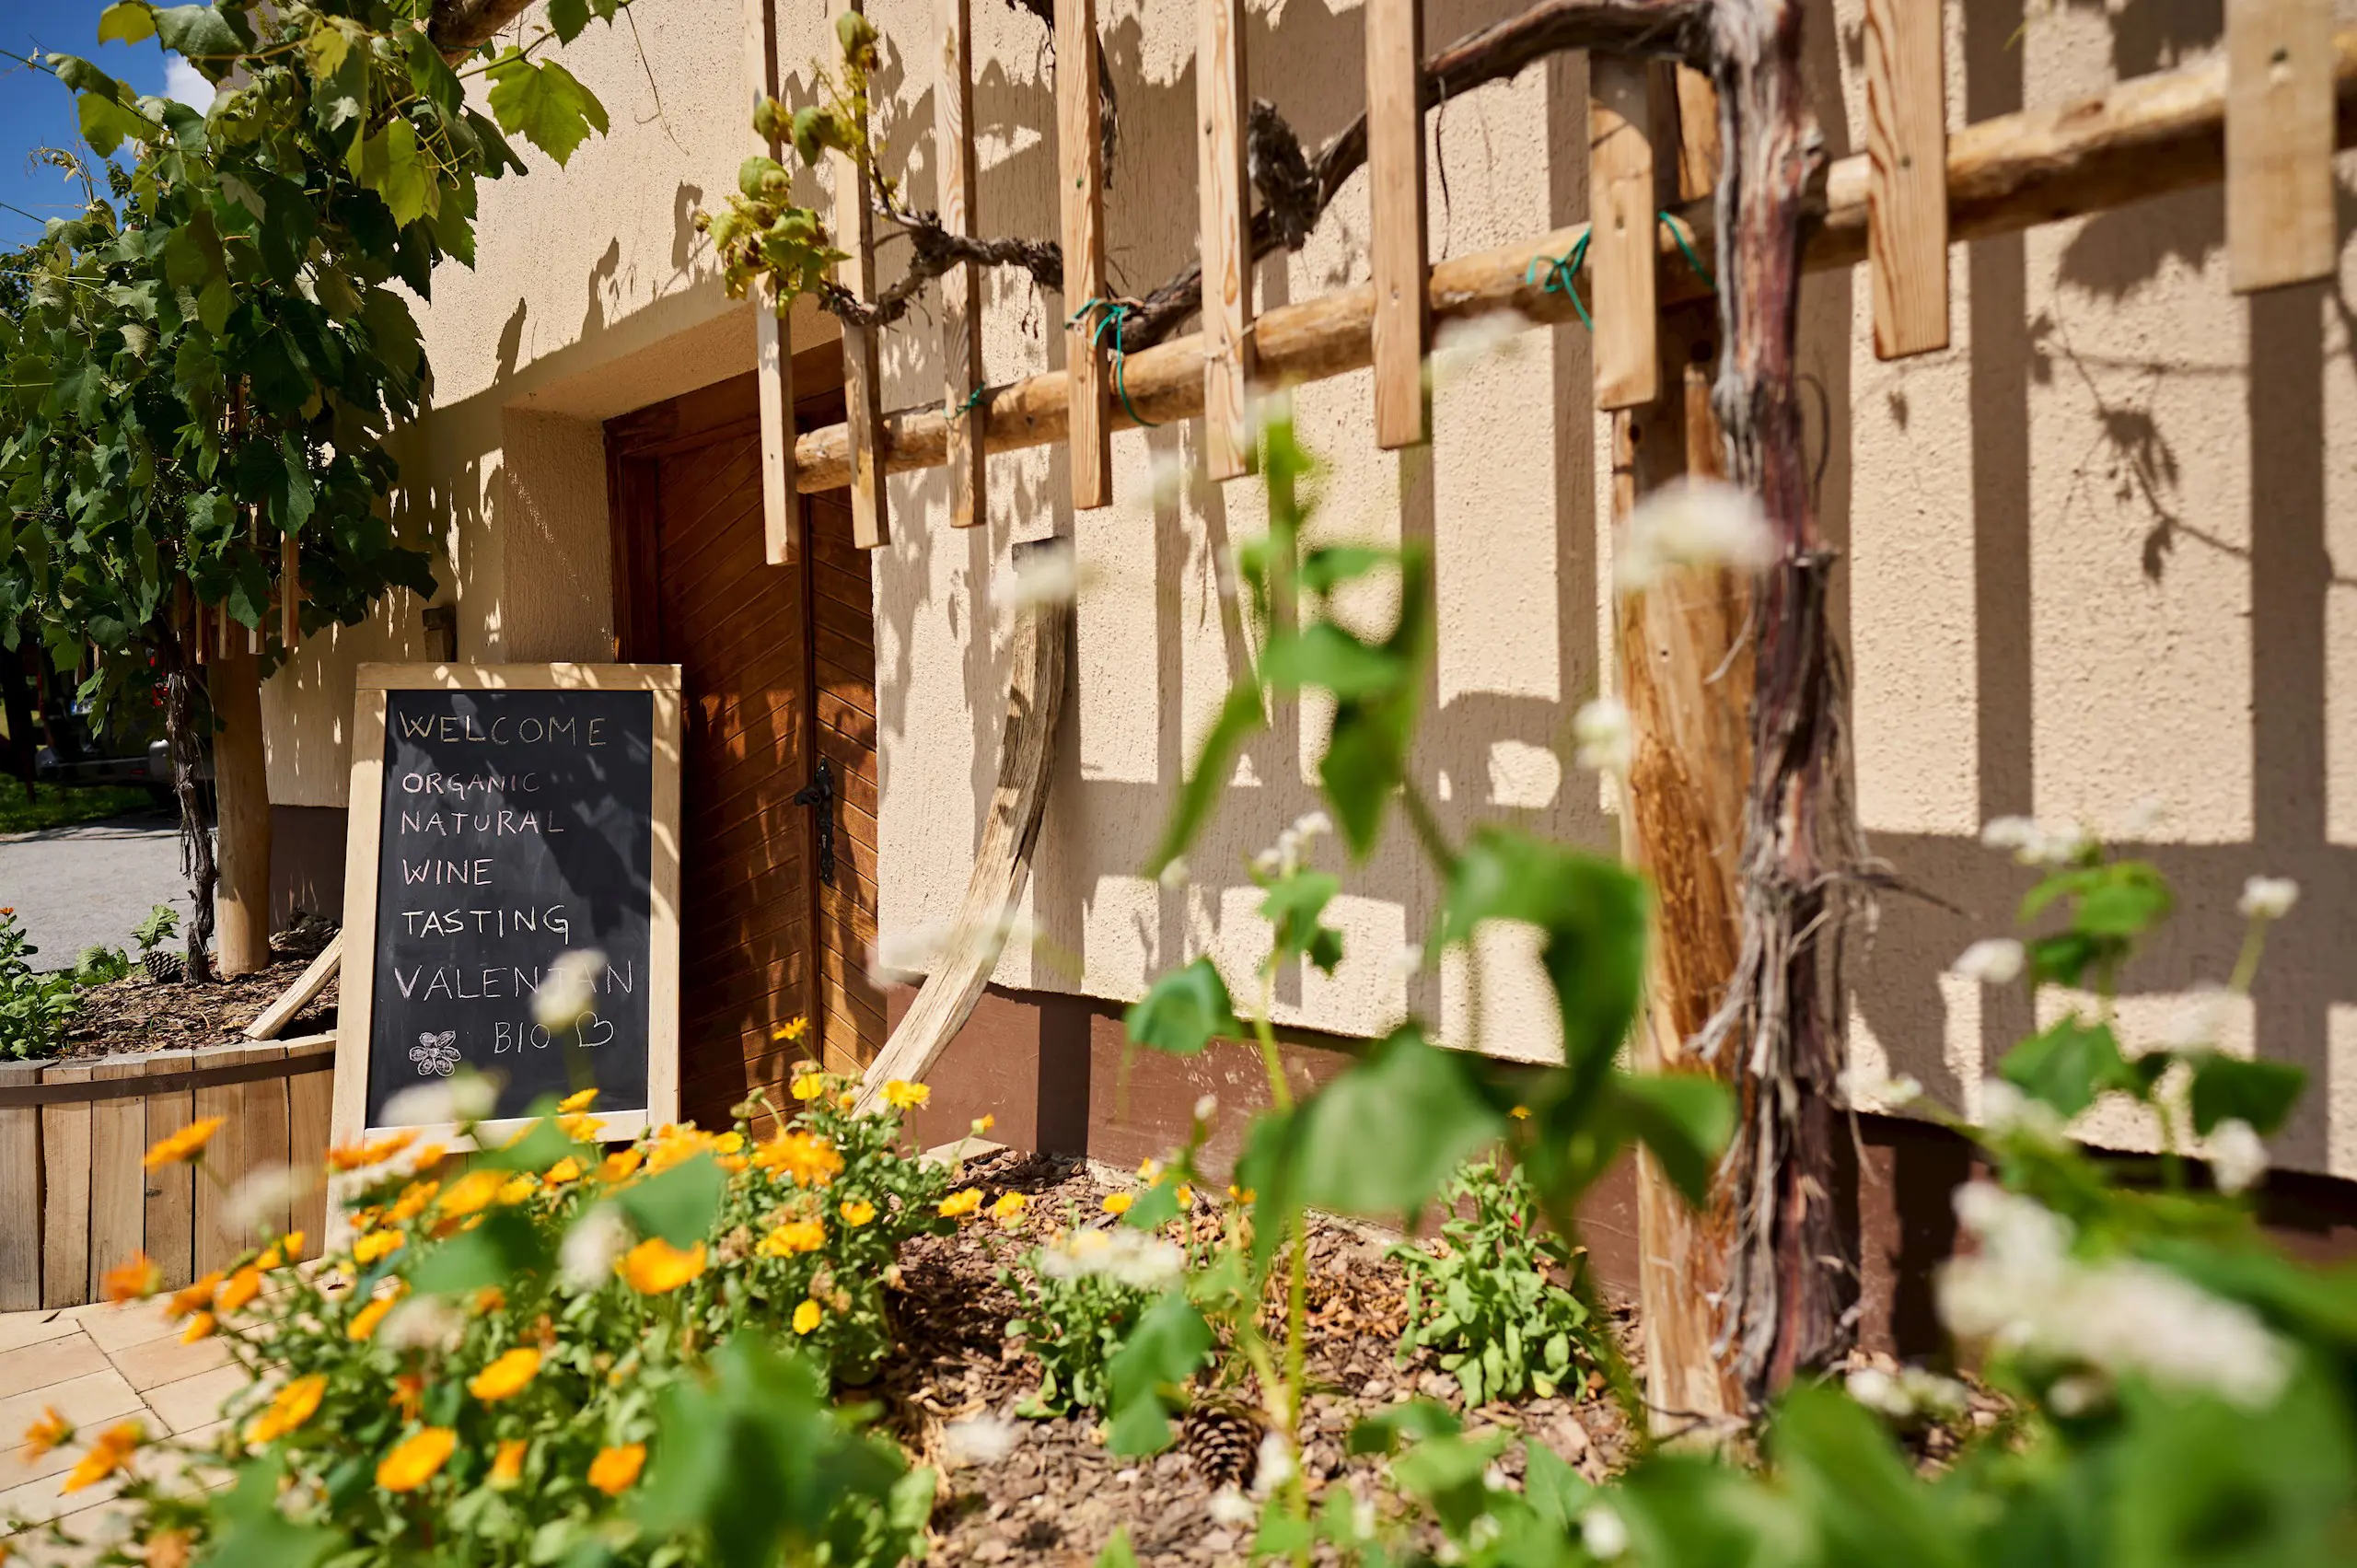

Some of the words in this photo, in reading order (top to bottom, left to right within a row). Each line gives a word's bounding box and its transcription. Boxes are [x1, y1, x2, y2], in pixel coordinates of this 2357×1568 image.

[400, 711, 606, 746] WELCOME
[402, 772, 540, 800] ORGANIC
[401, 810, 564, 836] NATURAL
[402, 858, 493, 885] WINE
[401, 904, 569, 945] TASTING
[493, 1021, 552, 1053] BIO
